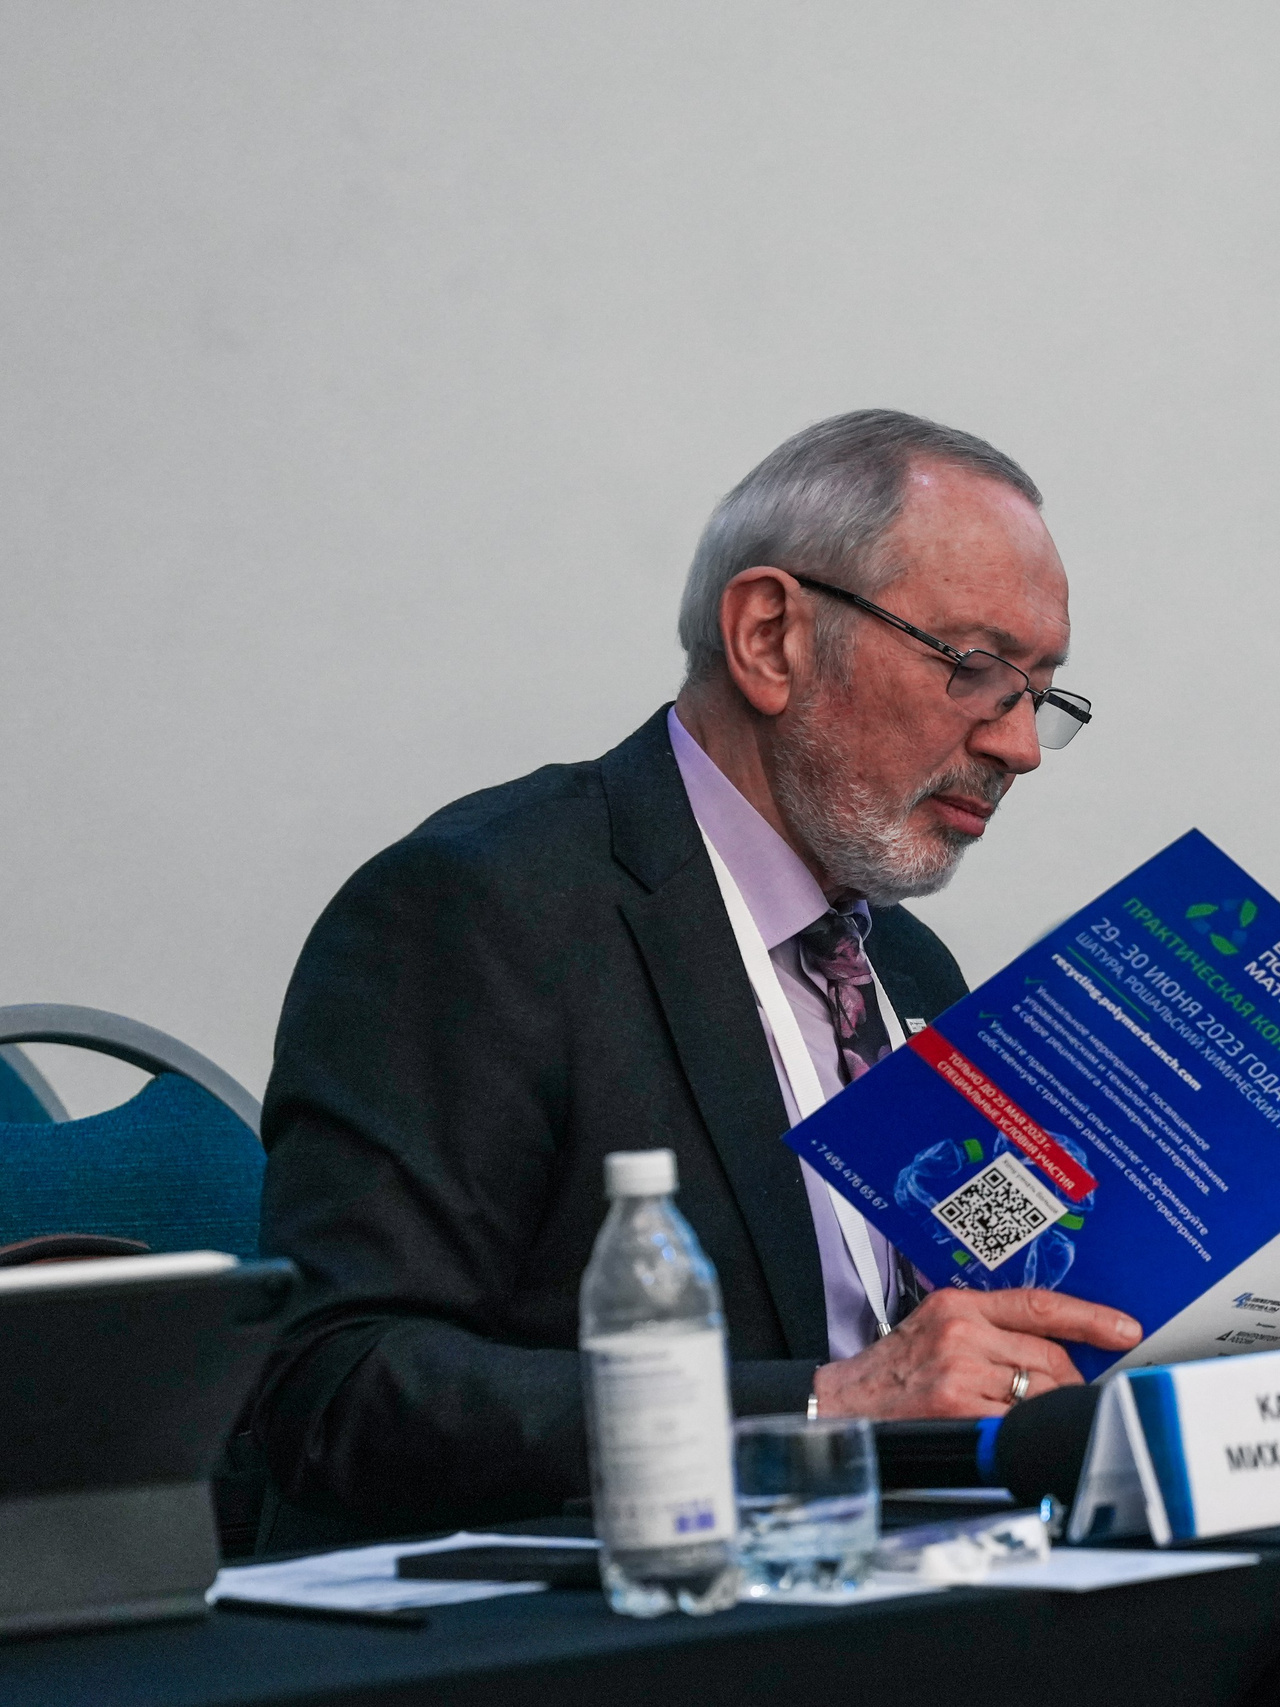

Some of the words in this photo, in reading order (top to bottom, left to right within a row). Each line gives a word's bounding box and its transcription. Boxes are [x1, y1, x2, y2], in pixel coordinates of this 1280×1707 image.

[1051, 953, 1201, 1090] recycling.polymerbranch.com
[1123, 897, 1255, 1017] ПРАКТИЧЕСКАЯ
[1143, 965, 1202, 1017] ИЮНЯ
[1195, 1013, 1244, 1056] 2023
[948, 1052, 983, 1085] ТОЛЬКО
[978, 1083, 996, 1097] ДО
[992, 1094, 1007, 1107] 25
[1003, 1104, 1026, 1125] МАЯ
[1022, 1122, 1047, 1144] 2023
[1019, 1011, 1049, 1037] сфере
[1045, 1036, 1101, 1086] рециклинга
[1099, 1084, 1157, 1139] полимерных
[1022, 995, 1099, 1064] управленческим
[1105, 1070, 1183, 1144] технологическим
[1179, 1143, 1228, 1192] решениям
[1036, 985, 1089, 1035] Уникальное
[1148, 1091, 1210, 1150] посвященное
[1123, 974, 1204, 1048] РОШАЛЬСКИЙ
[1200, 1046, 1280, 1122] ХИМИЧЕСКИЙ
[824, 1151, 844, 1170] 495
[842, 1168, 862, 1187] 476
[859, 1184, 875, 1199] 65
[871, 1196, 888, 1209] 67
[937, 1060, 1000, 1119] СПЕЦИАЛЬНЫЕ
[997, 1116, 1038, 1154] УСЛОВИЯ
[1034, 1151, 1075, 1190] УЧАСТИЯ
[977, 1030, 1037, 1085] собственную
[1035, 1084, 1084, 1129] стратегию
[1080, 1127, 1125, 1169] развития
[1123, 1168, 1155, 1200] своего
[1154, 1199, 1211, 1261] предприятия
[990, 1020, 1026, 1056] Узнайте
[1025, 1054, 1089, 1113] практический
[1086, 1112, 1112, 1134] опыт
[1110, 1134, 1142, 1164] коллег
[1148, 1172, 1208, 1235] сформируйте
